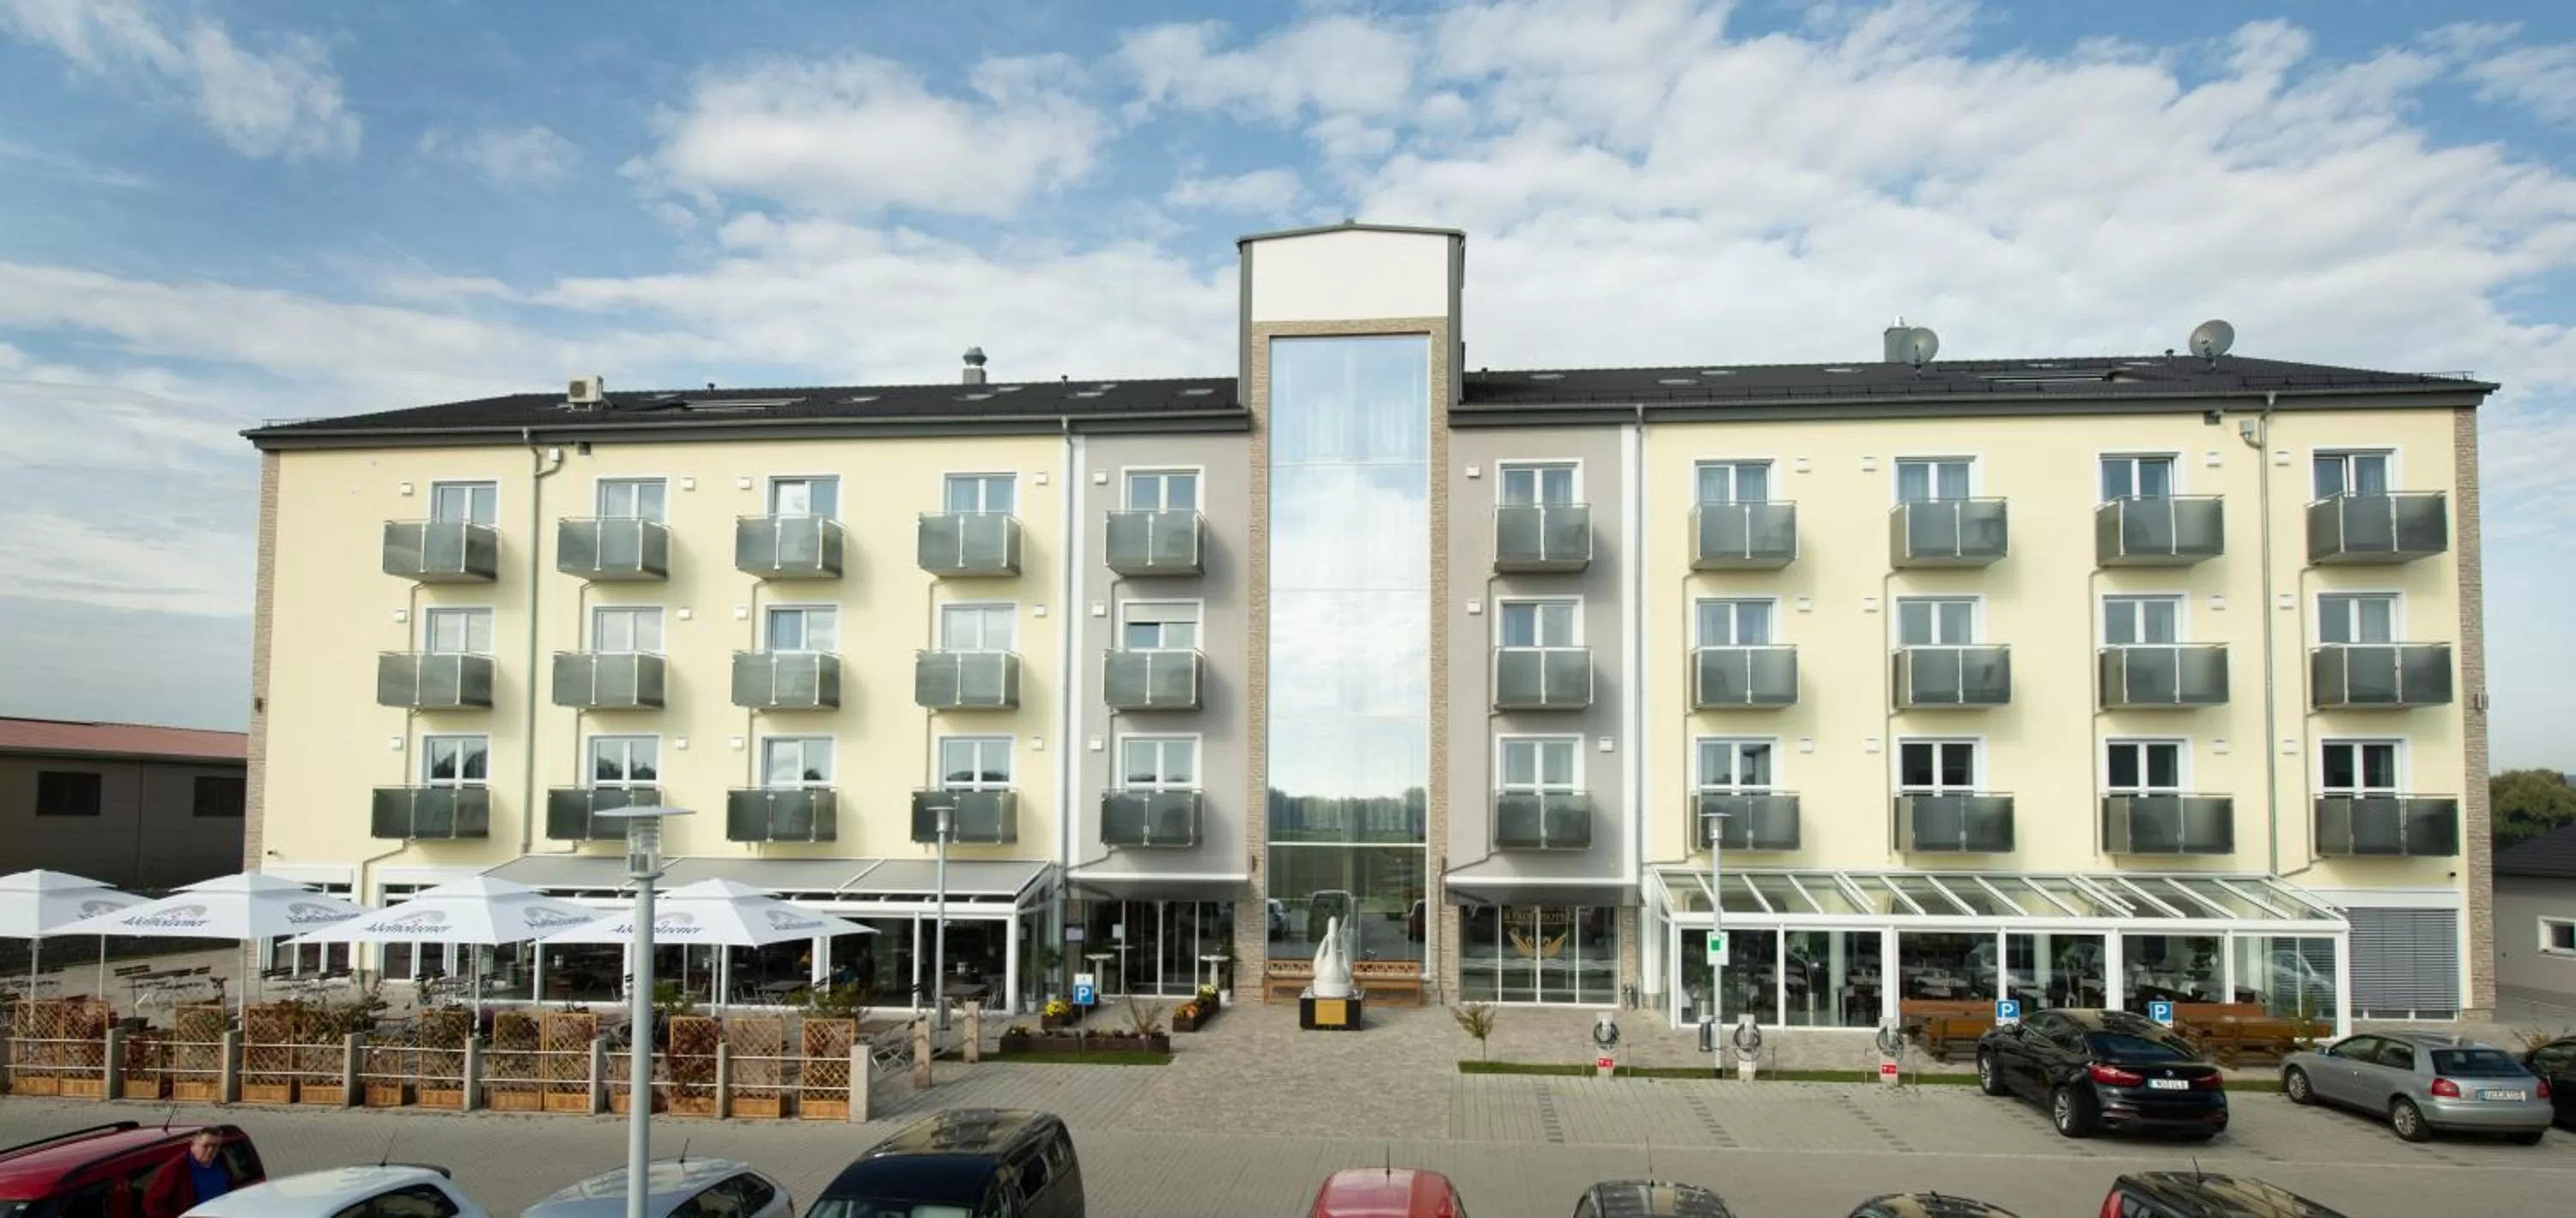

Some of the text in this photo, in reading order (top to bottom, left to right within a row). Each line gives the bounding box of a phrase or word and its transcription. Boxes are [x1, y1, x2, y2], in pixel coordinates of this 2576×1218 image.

[1078, 987, 1089, 1001] P
[2002, 1003, 2014, 1018] P
[2155, 1005, 2166, 1020] P
